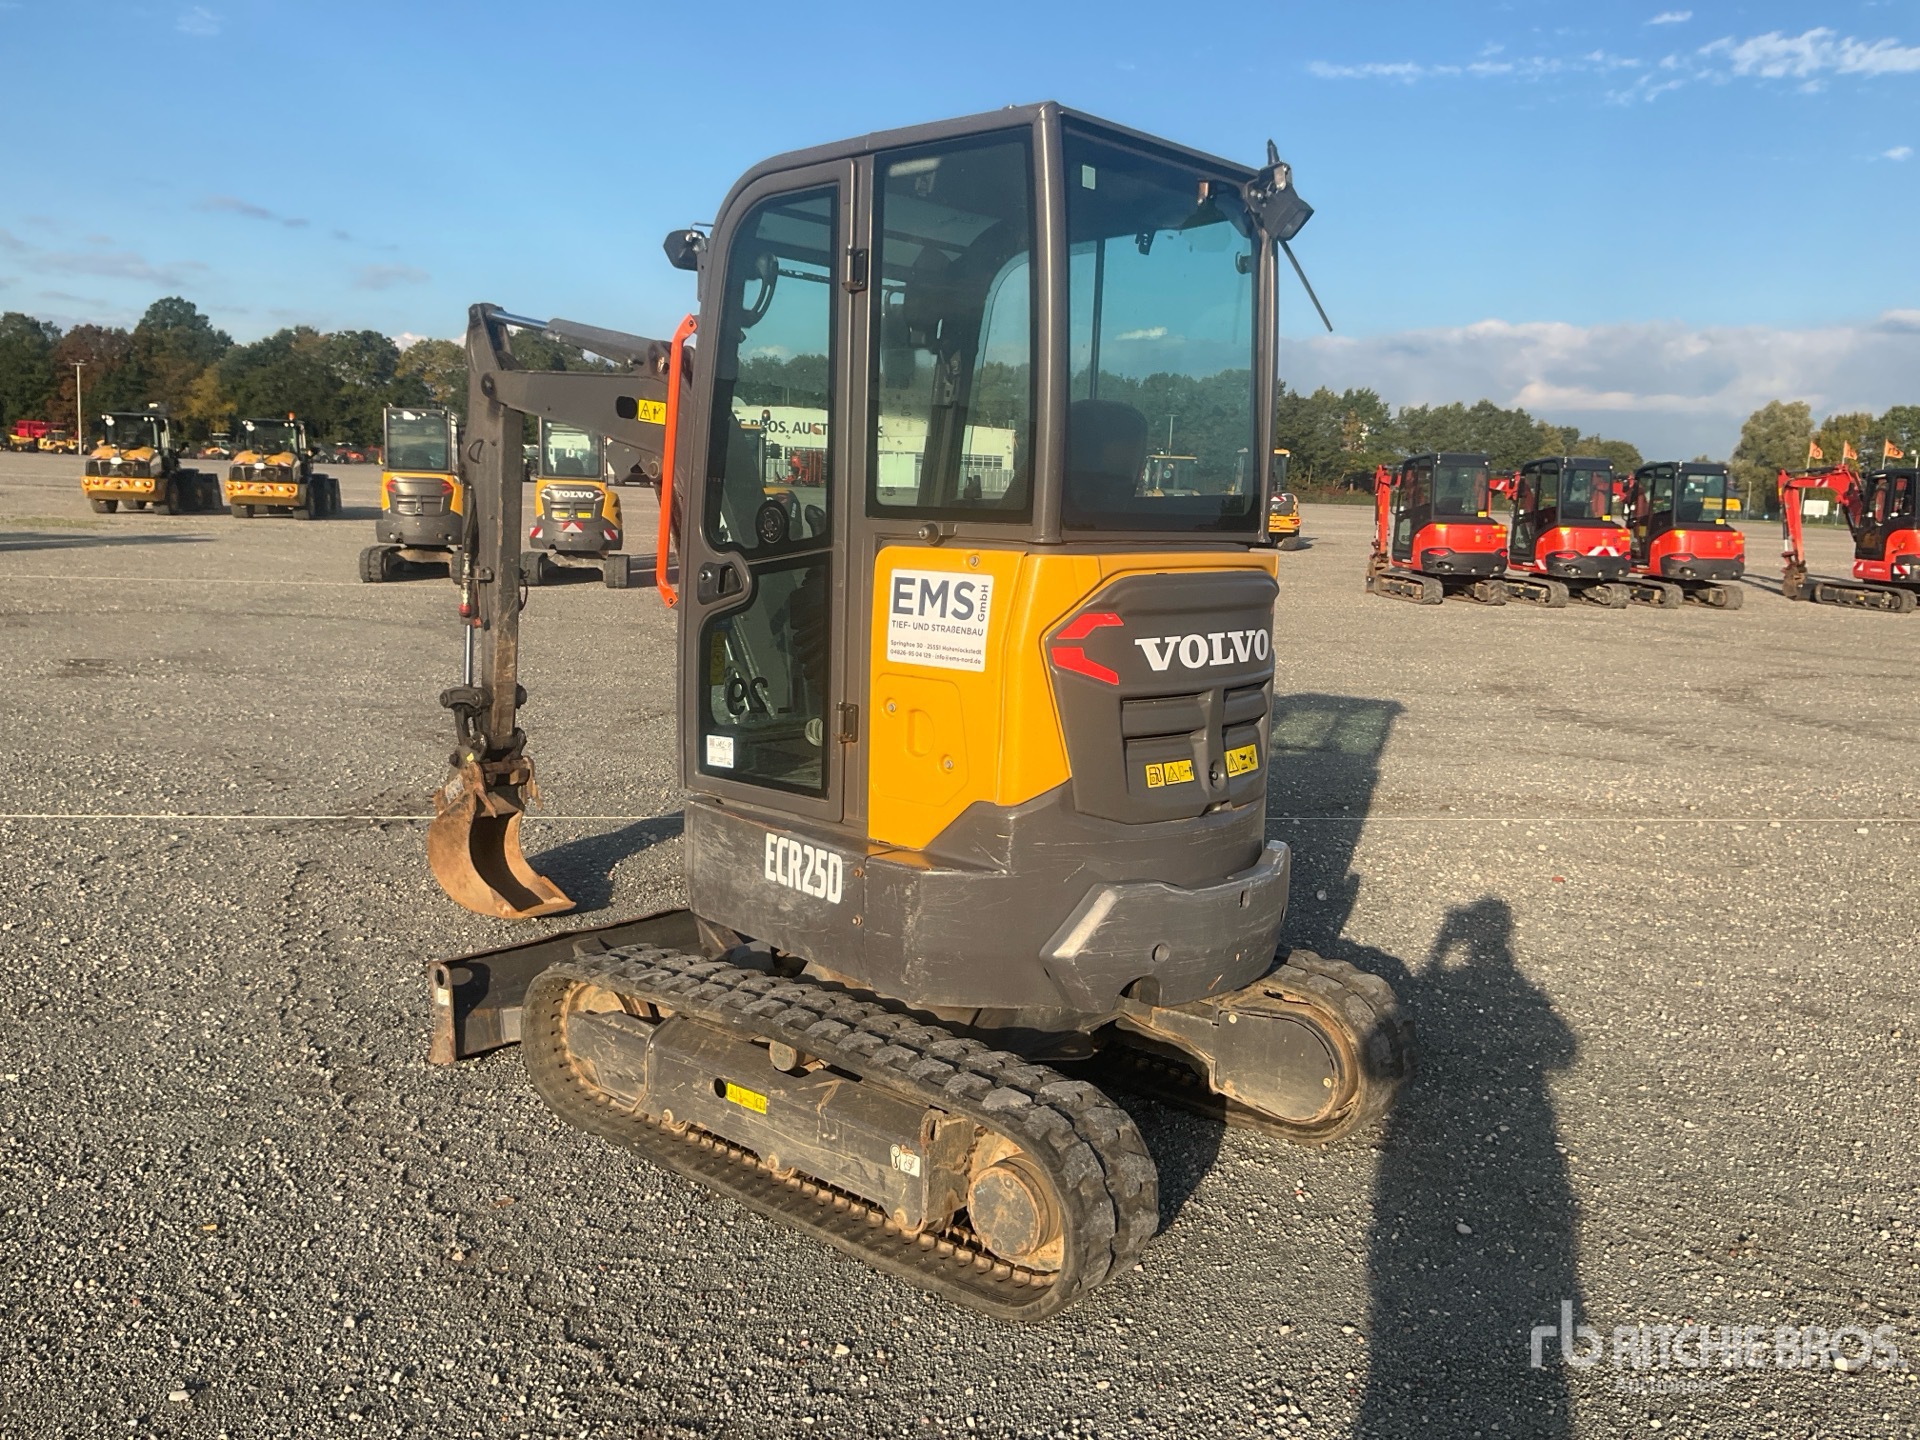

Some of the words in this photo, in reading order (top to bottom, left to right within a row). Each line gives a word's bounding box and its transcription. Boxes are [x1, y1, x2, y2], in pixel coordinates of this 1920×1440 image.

[553, 490, 594, 498] VOLVO
[892, 577, 976, 620] EMS
[977, 584, 989, 622] GmbH
[891, 619, 911, 629] TIEF-
[912, 621, 930, 631] UND
[1134, 628, 1269, 671] VOLVO
[764, 832, 843, 905] ECR25D
